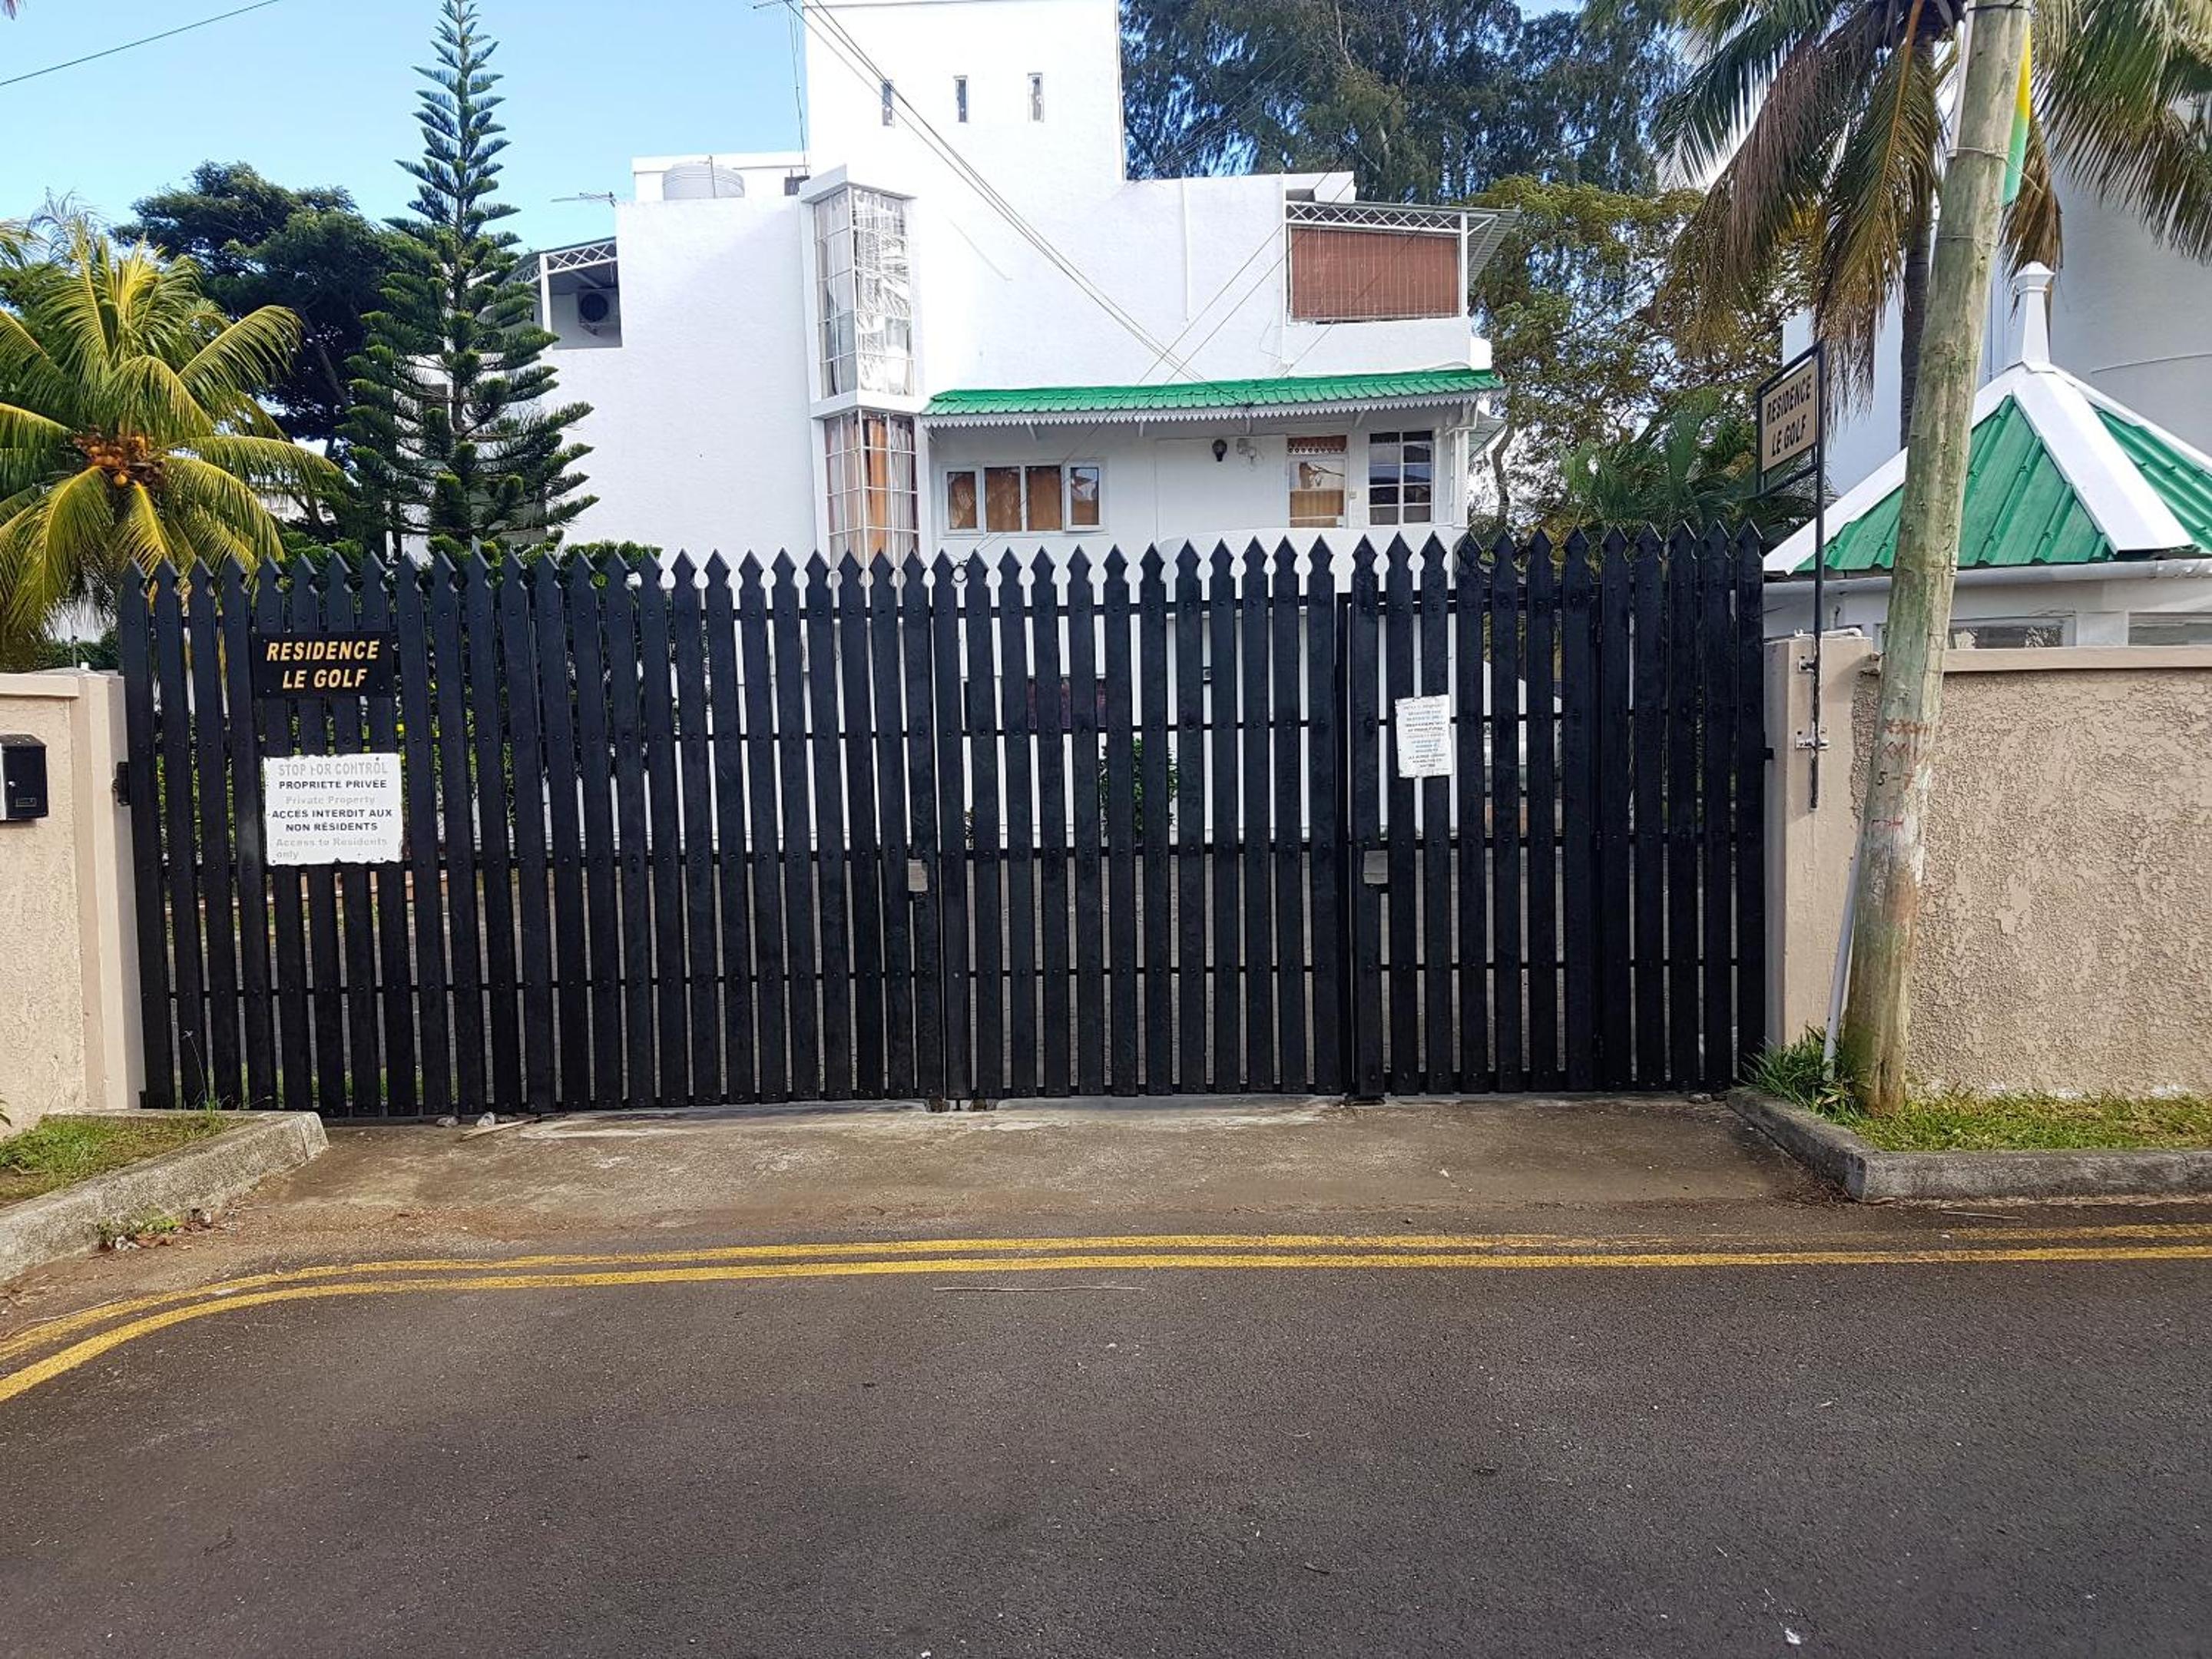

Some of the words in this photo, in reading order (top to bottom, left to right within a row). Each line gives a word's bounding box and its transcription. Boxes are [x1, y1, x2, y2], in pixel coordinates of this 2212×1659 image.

[1767, 374, 1811, 426] RESIDENCE
[1771, 430, 1782, 457] LE
[1784, 414, 1806, 449] GOLF
[267, 640, 379, 661] RESIDENCE
[283, 670, 307, 689] LE
[313, 668, 367, 688] GOLF
[279, 763, 308, 776] STOP
[335, 761, 389, 775] CONTROL
[286, 796, 323, 804] Private
[329, 796, 376, 805] Property
[312, 809, 365, 818] INTERDIT
[369, 808, 392, 818] AUX
[286, 823, 311, 832] NON
[276, 839, 315, 847] Access
[320, 838, 329, 846] to
[276, 851, 300, 859] only
